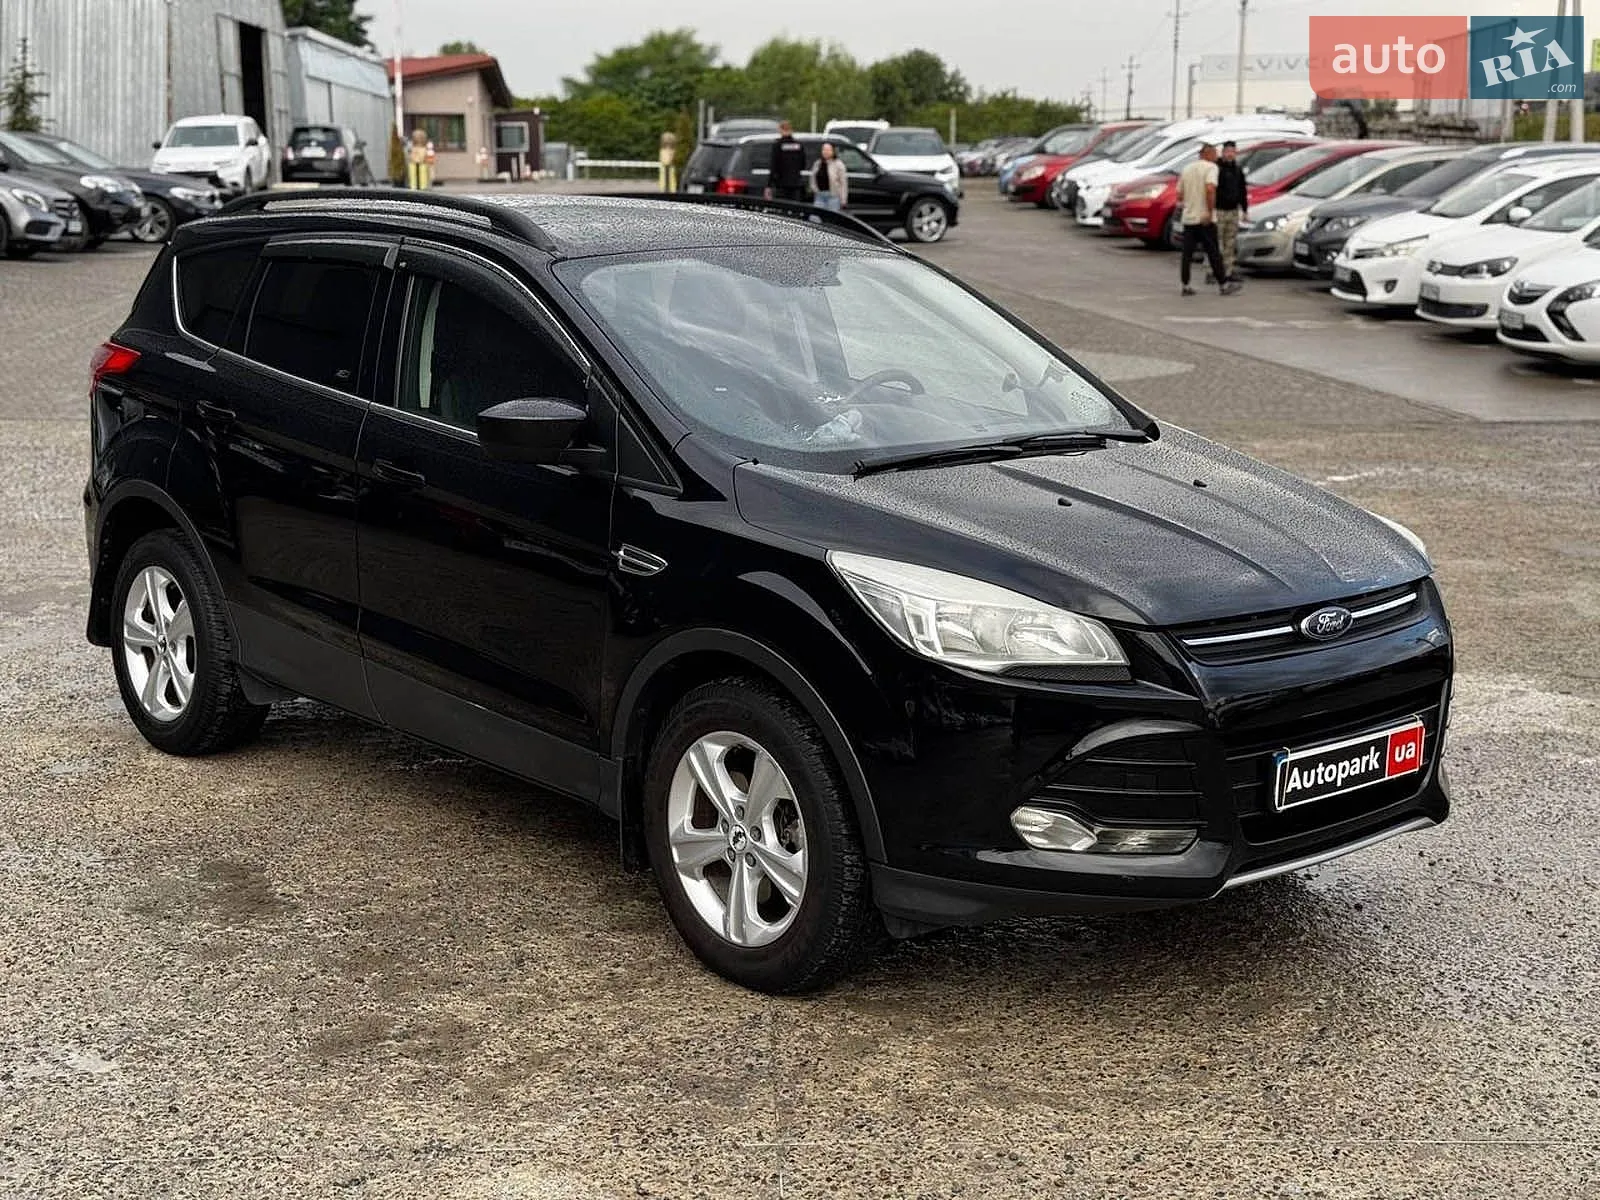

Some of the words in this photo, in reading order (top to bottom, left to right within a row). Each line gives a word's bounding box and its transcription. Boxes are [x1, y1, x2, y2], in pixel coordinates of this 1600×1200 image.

[1317, 612, 1346, 634] Ford
[1286, 746, 1381, 793] Autopark
[1394, 741, 1416, 763] ua
